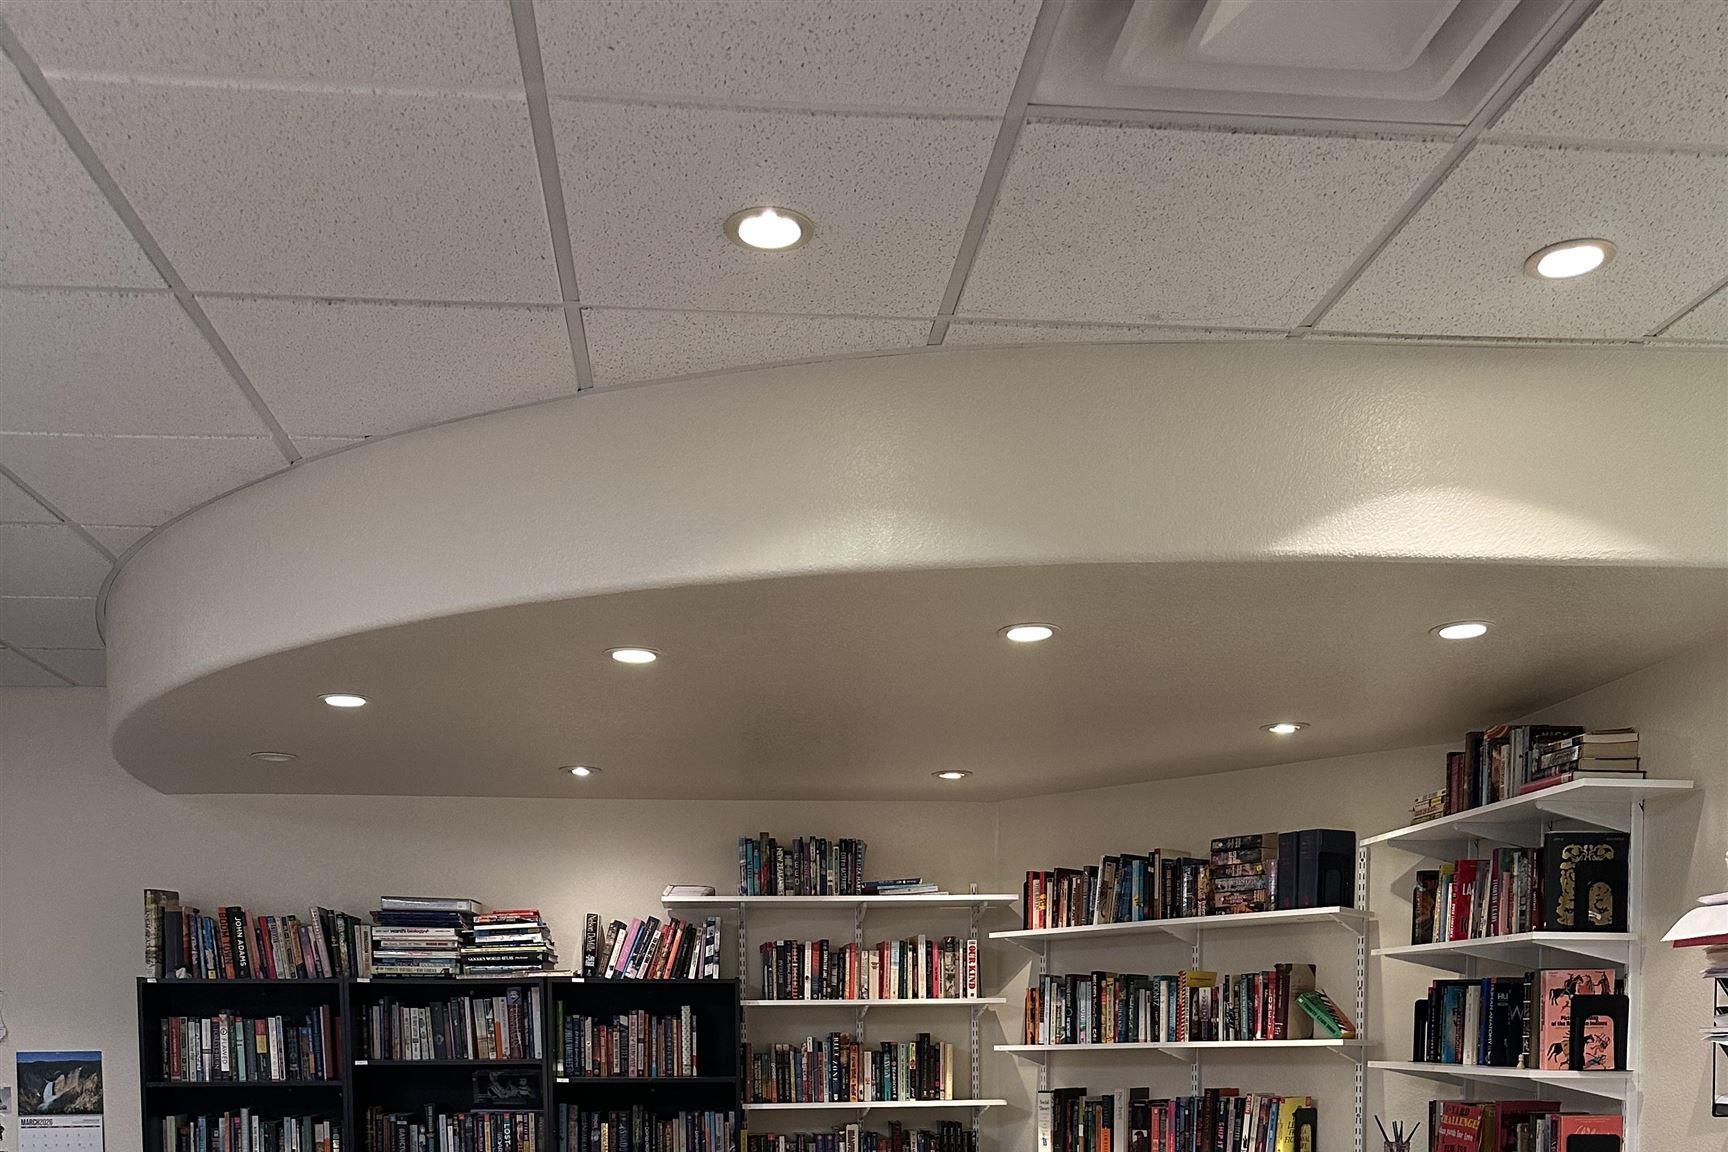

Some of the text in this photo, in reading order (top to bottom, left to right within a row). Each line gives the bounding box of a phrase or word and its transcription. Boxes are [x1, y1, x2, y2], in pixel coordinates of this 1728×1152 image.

[219, 913, 228, 938] BOOM
[234, 916, 247, 967] JOHN ADAMS
